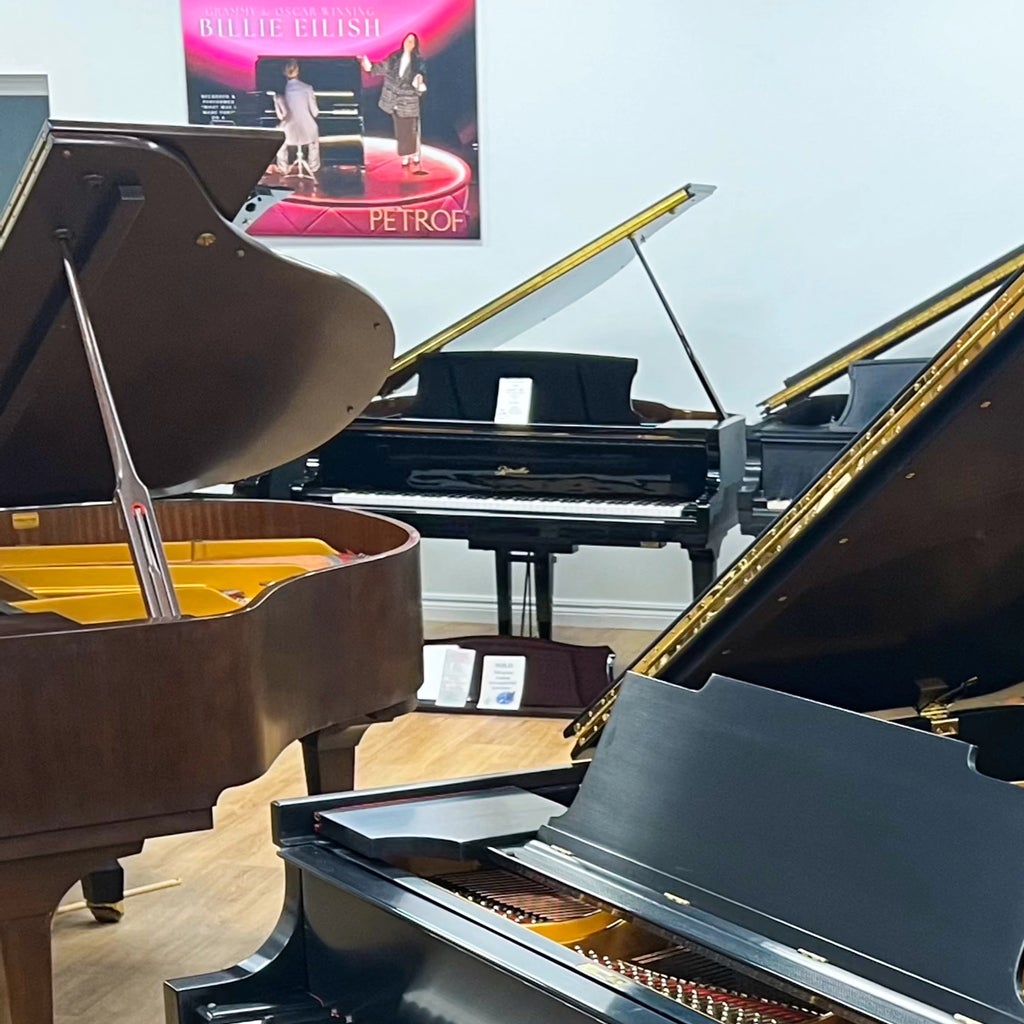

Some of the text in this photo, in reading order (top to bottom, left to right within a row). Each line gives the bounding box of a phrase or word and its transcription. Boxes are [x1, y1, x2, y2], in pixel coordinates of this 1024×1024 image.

[205, 7, 255, 17] GRAMMY
[275, 7, 317, 17] OSCAR
[321, 7, 375, 17] WINNING
[199, 18, 381, 38] BILLIE EILISH
[369, 208, 464, 232] PETROF
